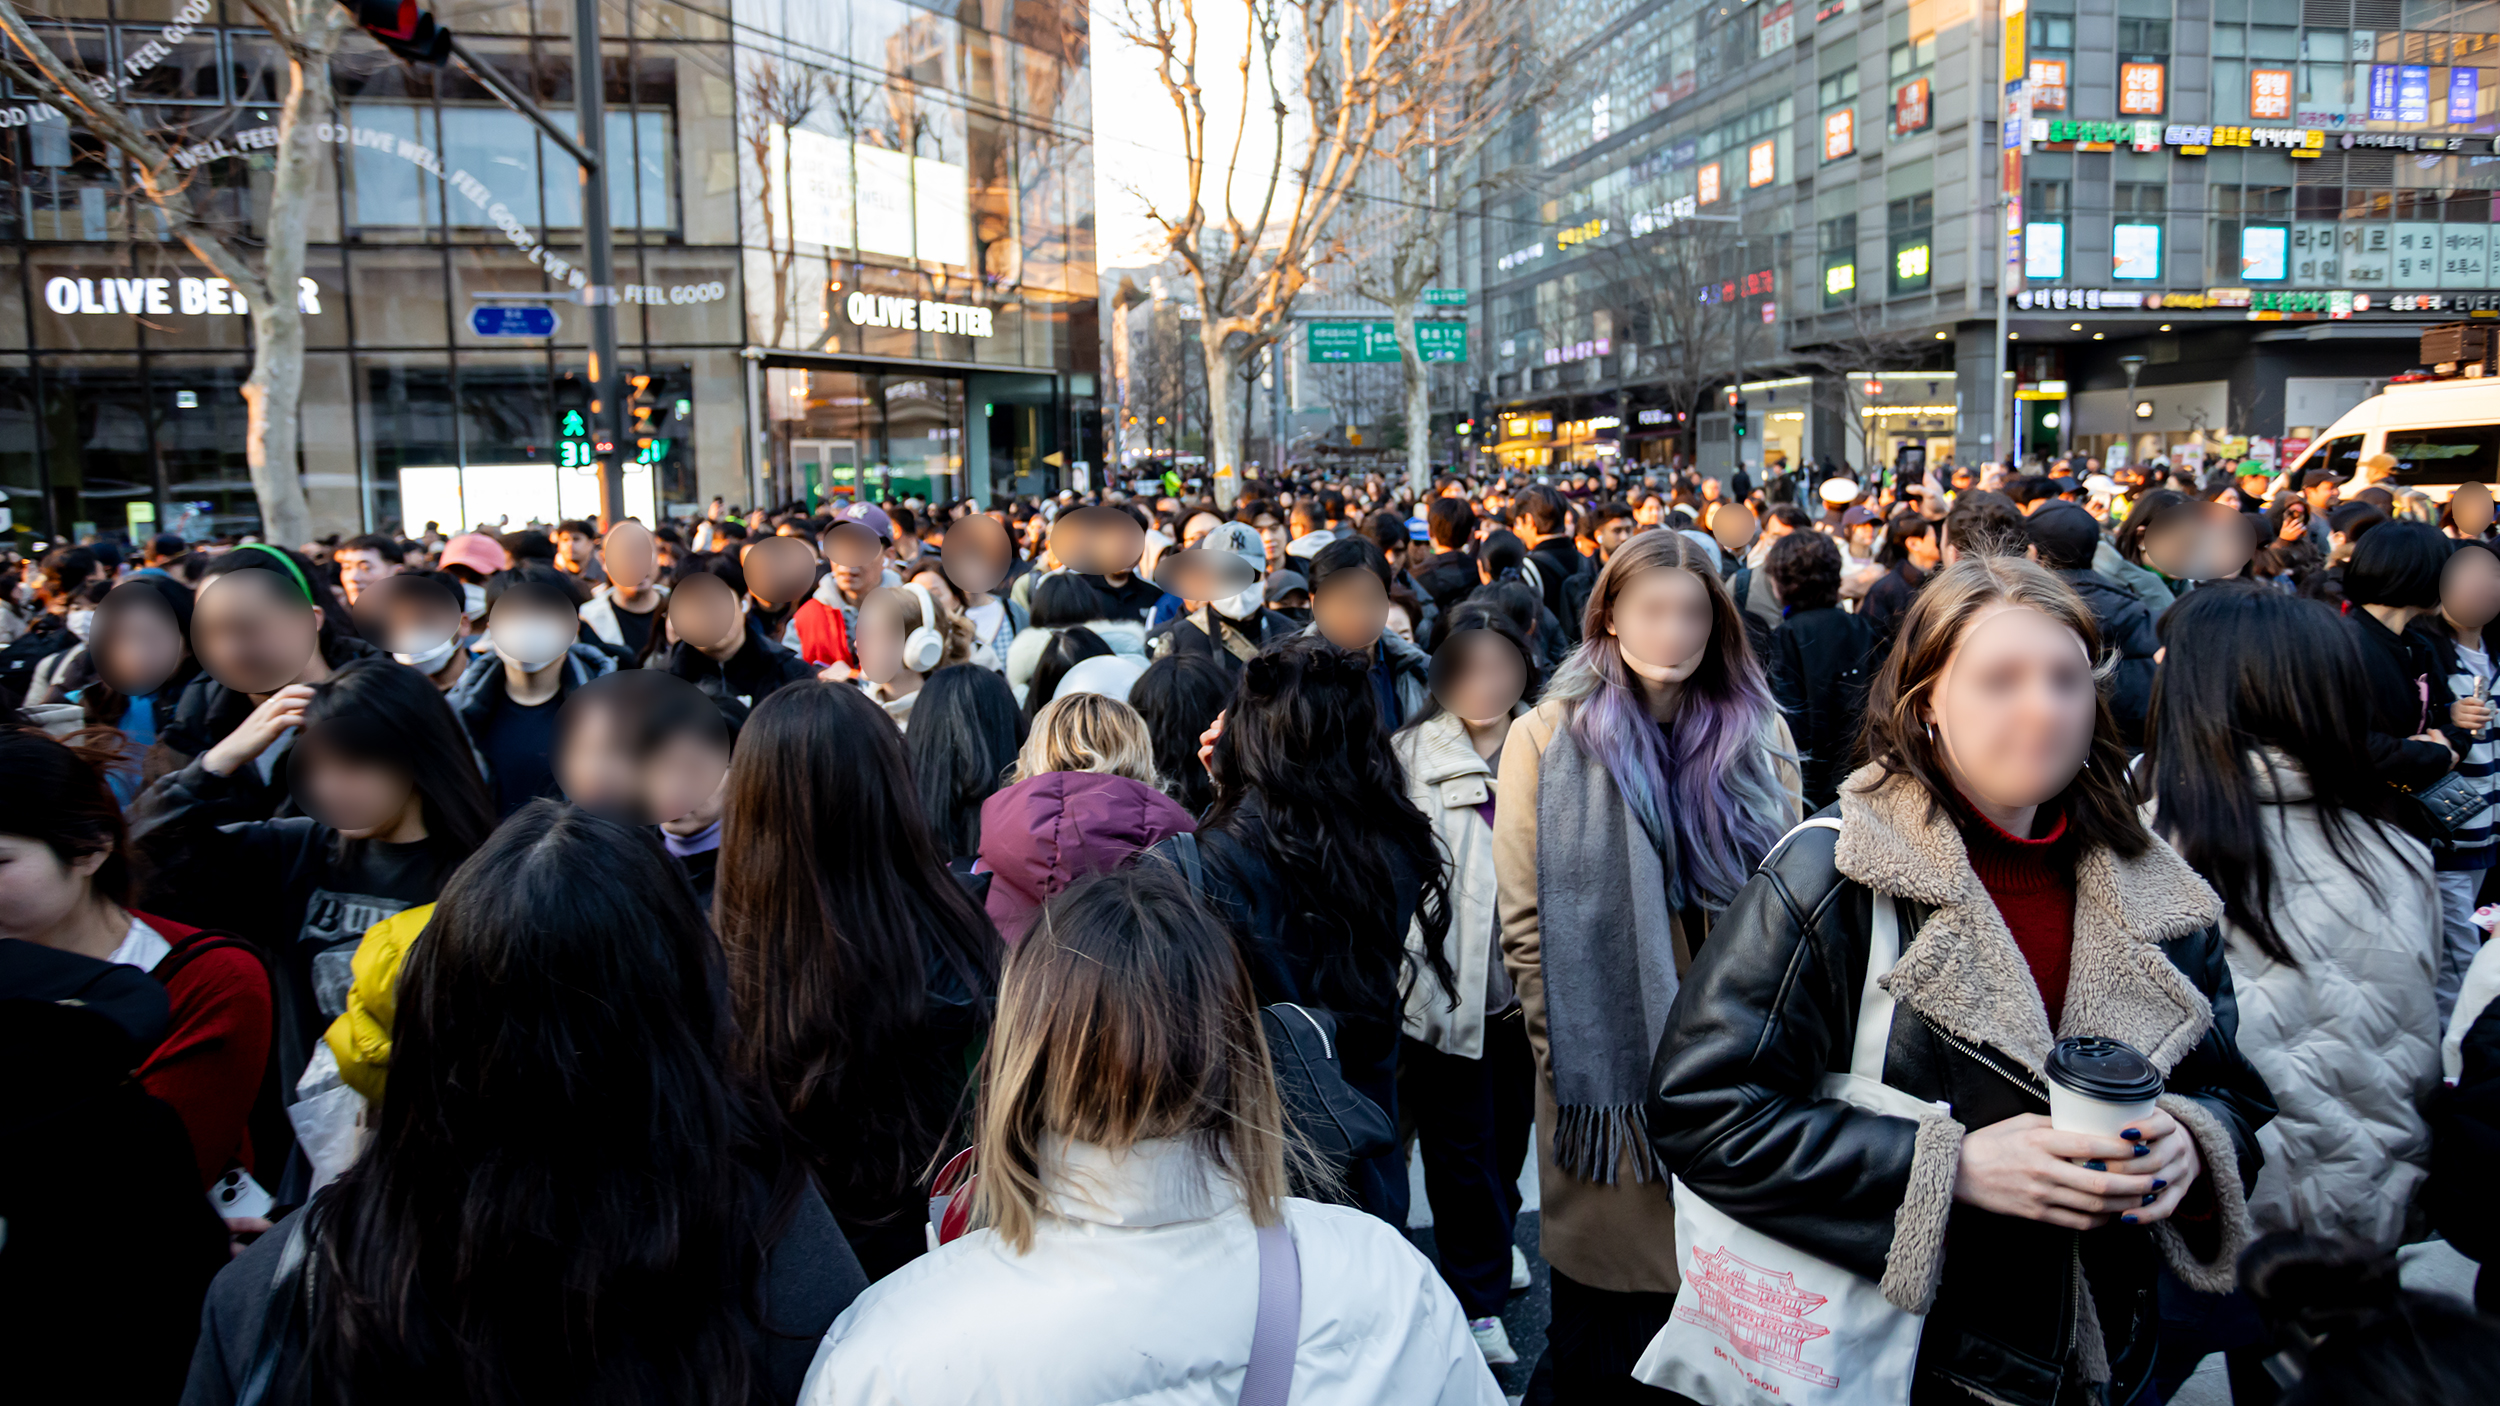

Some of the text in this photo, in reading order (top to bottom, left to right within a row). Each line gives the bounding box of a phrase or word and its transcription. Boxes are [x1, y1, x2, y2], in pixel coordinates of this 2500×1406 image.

[124, 40, 172, 76] FEEL
[2125, 68, 2158, 91] 신경
[2255, 73, 2287, 95] 정형
[2125, 90, 2158, 112] 외과
[2252, 127, 2306, 148] 아카데미
[351, 126, 395, 154] LIVE
[449, 168, 491, 210] FEEL
[624, 284, 668, 306] FEEL
[669, 280, 726, 305] GOOD
[2445, 234, 2484, 251] 레이저
[2443, 258, 2481, 277] 보톡스
[45, 276, 322, 315] OLIVE BER
[2455, 296, 2487, 311] EVE
[847, 291, 994, 338] OLIVE BETTER
[560, 440, 591, 467] 31
[1230, 531, 1246, 549] NY
[1714, 1346, 1728, 1361] Be
[1746, 1372, 1780, 1396] Seoul
